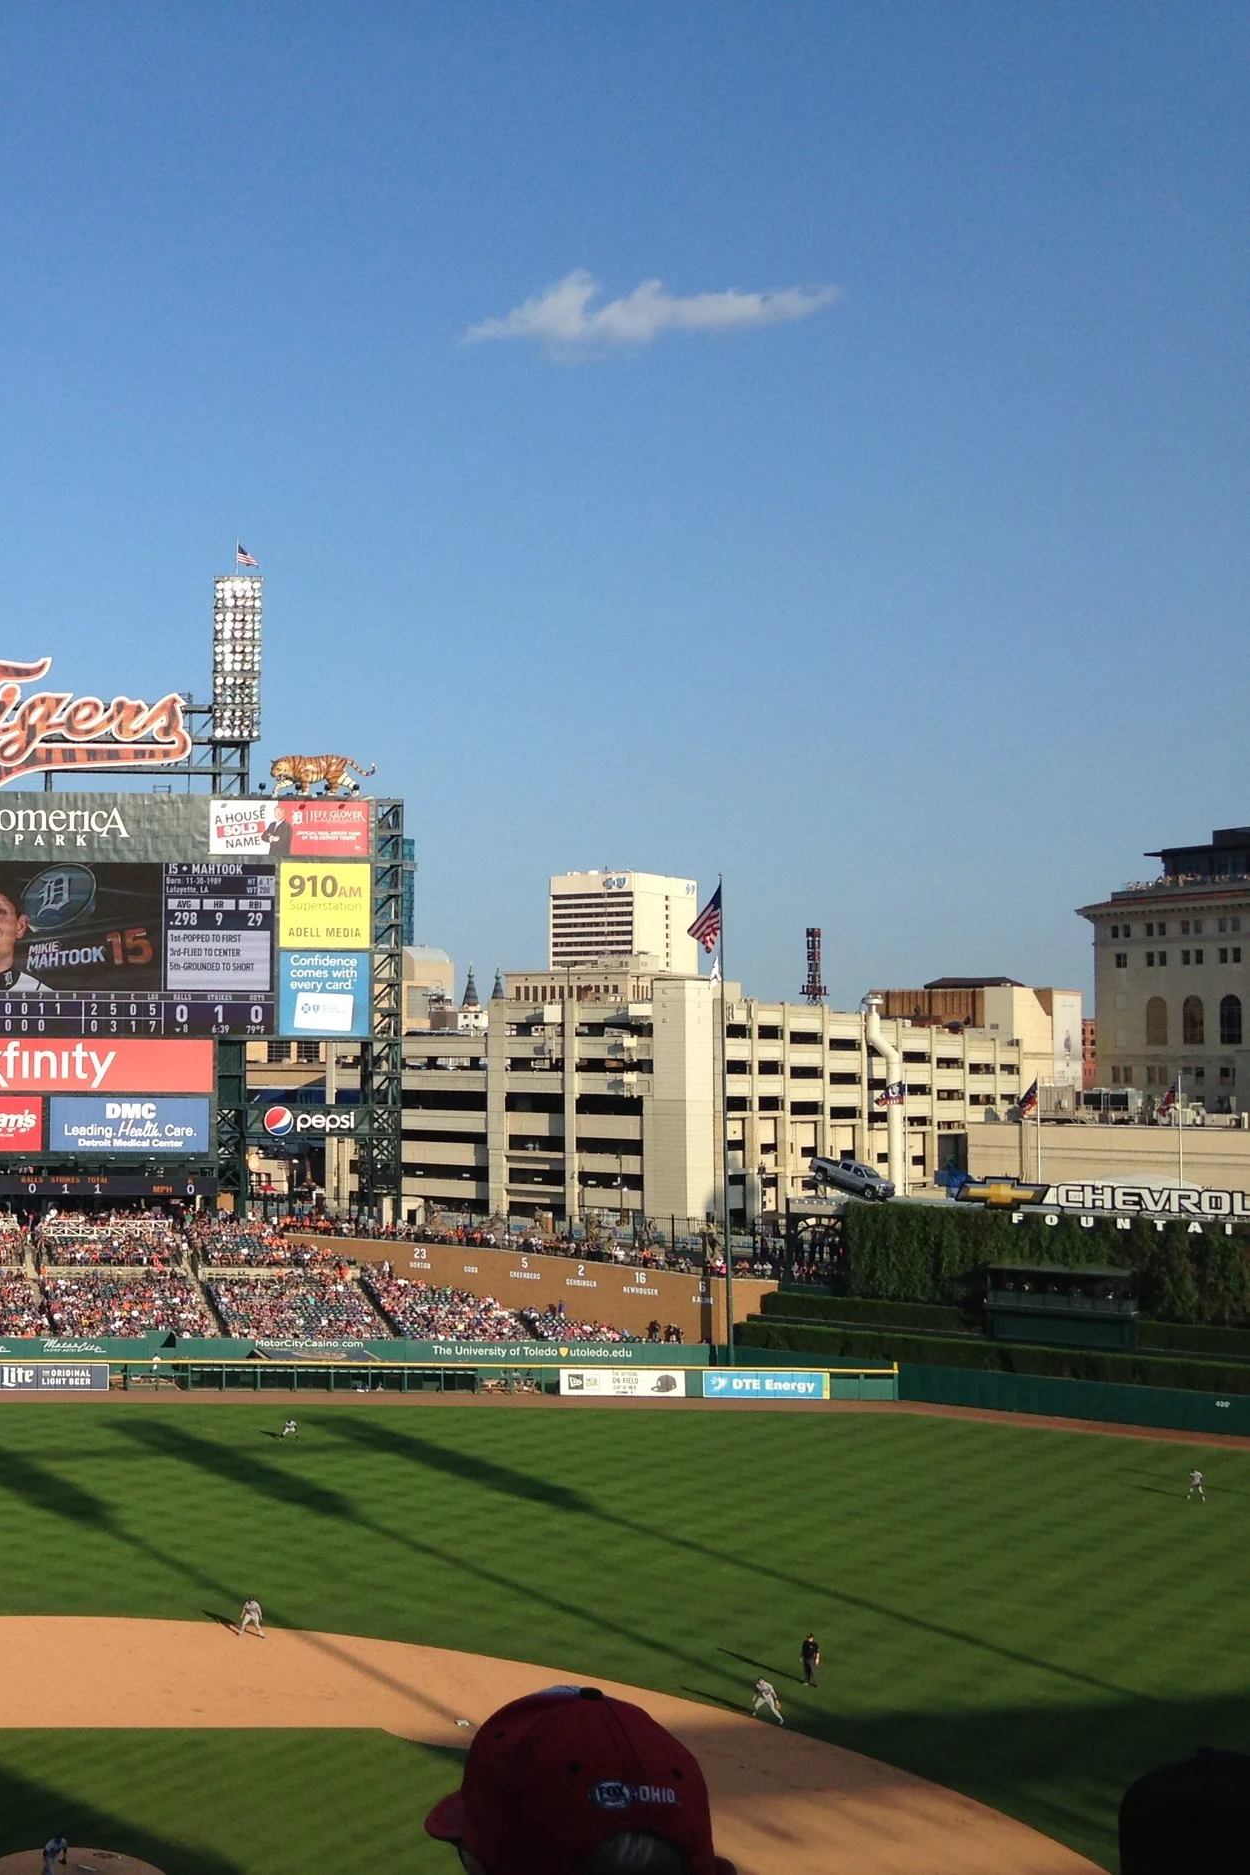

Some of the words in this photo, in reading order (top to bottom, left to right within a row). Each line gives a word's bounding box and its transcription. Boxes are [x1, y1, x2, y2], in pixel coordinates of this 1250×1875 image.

[215, 815, 222, 824] A
[226, 808, 266, 823] HOUSE
[310, 811, 328, 822] JEFF
[330, 811, 366, 822] GLOVER
[223, 823, 258, 837] SOLD
[14, 834, 87, 846] PARK
[226, 836, 261, 849] NAME
[168, 863, 178, 874] 15
[192, 864, 243, 875] MAHTOOK
[249, 901, 262, 909] RBI
[290, 900, 362, 911] Superstation
[170, 912, 198, 926] .298
[215, 912, 223, 926] 9
[247, 913, 263, 926] 29
[212, 934, 220, 942] TO
[288, 928, 321, 937] ADELL
[326, 928, 361, 938] MEDIA
[28, 941, 60, 955] MIKIE
[107, 927, 153, 966] 15
[26, 946, 106, 971] MAHTOOK
[204, 949, 212, 957] TO
[214, 949, 240, 957] CENTER
[222, 963, 230, 971] TO
[232, 963, 254, 971] SHORT
[290, 955, 358, 967] Confidence
[290, 969, 328, 978] comes
[332, 968, 357, 978] with
[290, 981, 322, 992] every
[176, 1004, 188, 1023] 0
[214, 1005, 223, 1023] 1
[250, 1005, 263, 1023] 0
[212, 1025, 229, 1034] 6:39
[106, 1103, 156, 1119] DMC
[296, 1111, 355, 1132] pepsi
[64, 1124, 116, 1138] Leading.
[118, 1119, 162, 1138] Health.
[165, 1124, 197, 1137] Care.
[78, 1138, 111, 1146] Detroit
[113, 1138, 150, 1147] Medical
[152, 1139, 183, 1147] Center
[28, 1183, 36, 1193] 0
[62, 1184, 70, 1194] 1
[94, 1184, 102, 1194] 1
[187, 1184, 195, 1194] 0
[1012, 1212, 1232, 1235] FOUNTAI
[414, 1247, 427, 1260] 23
[522, 1257, 528, 1269] 5
[578, 1265, 585, 1276] 2
[635, 1272, 646, 1284] 16
[256, 1339, 364, 1349] MotorCityCasino.com
[433, 1346, 452, 1355] The
[455, 1345, 506, 1357] University
[509, 1346, 520, 1356] of
[522, 1346, 557, 1357] Toledo
[570, 1347, 632, 1358] utoledo.edu
[2, 1367, 34, 1387] Lite
[51, 1369, 91, 1377] ORIGINAL
[732, 1378, 761, 1390] DTE
[765, 1378, 815, 1393] Energy
[639, 1786, 676, 1802] OHIO
